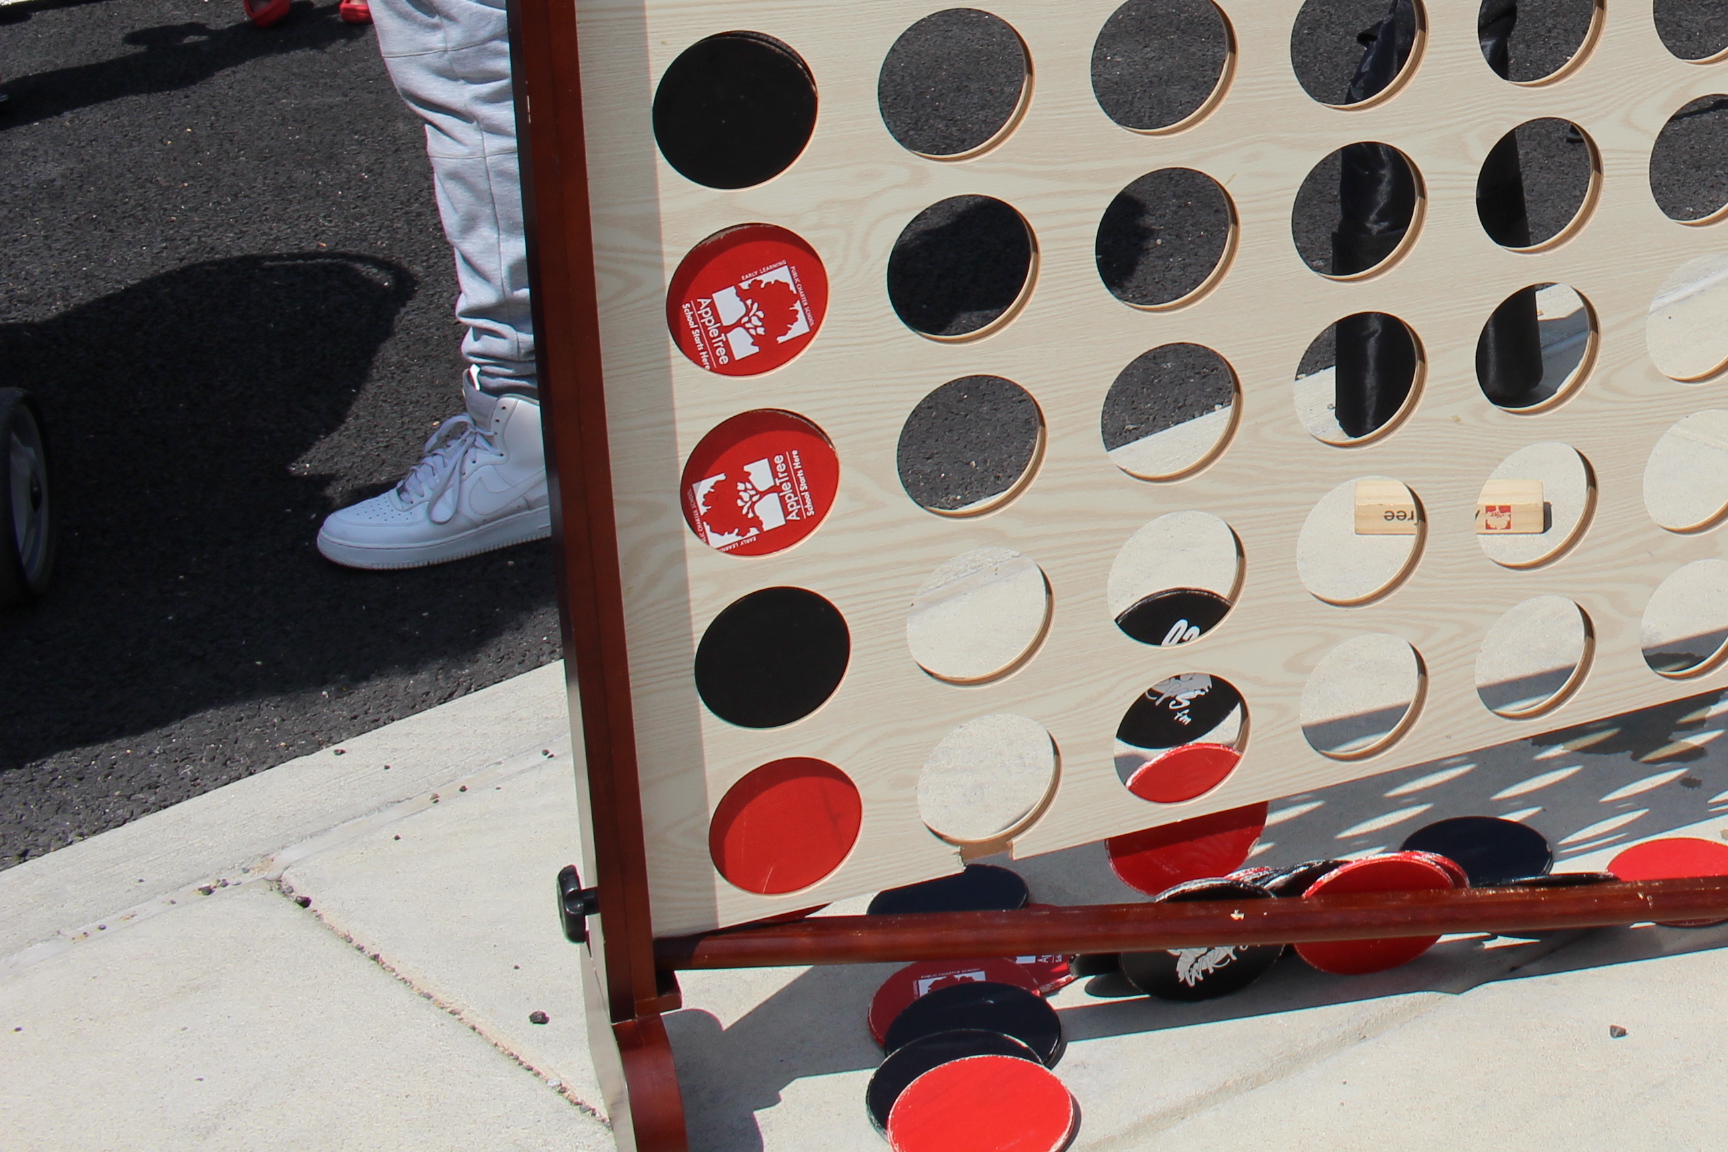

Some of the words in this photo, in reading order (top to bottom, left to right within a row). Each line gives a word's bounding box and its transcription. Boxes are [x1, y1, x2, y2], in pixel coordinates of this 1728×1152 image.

[741, 270, 758, 281] EARLY
[759, 259, 787, 274] LEARNING
[790, 265, 799, 283] PUBLIC
[796, 283, 808, 306] CHARTER
[804, 306, 815, 327] SCHOOL
[681, 302, 699, 328] School
[691, 328, 704, 351] Starts
[700, 350, 711, 370] Here
[696, 298, 729, 365] AppleTree
[791, 449, 802, 469] Here
[774, 454, 801, 521] AppleTree
[797, 469, 808, 491] Starts
[801, 491, 815, 517] School
[739, 535, 757, 546] EARLY
[1173, 709, 1192, 726] fm
